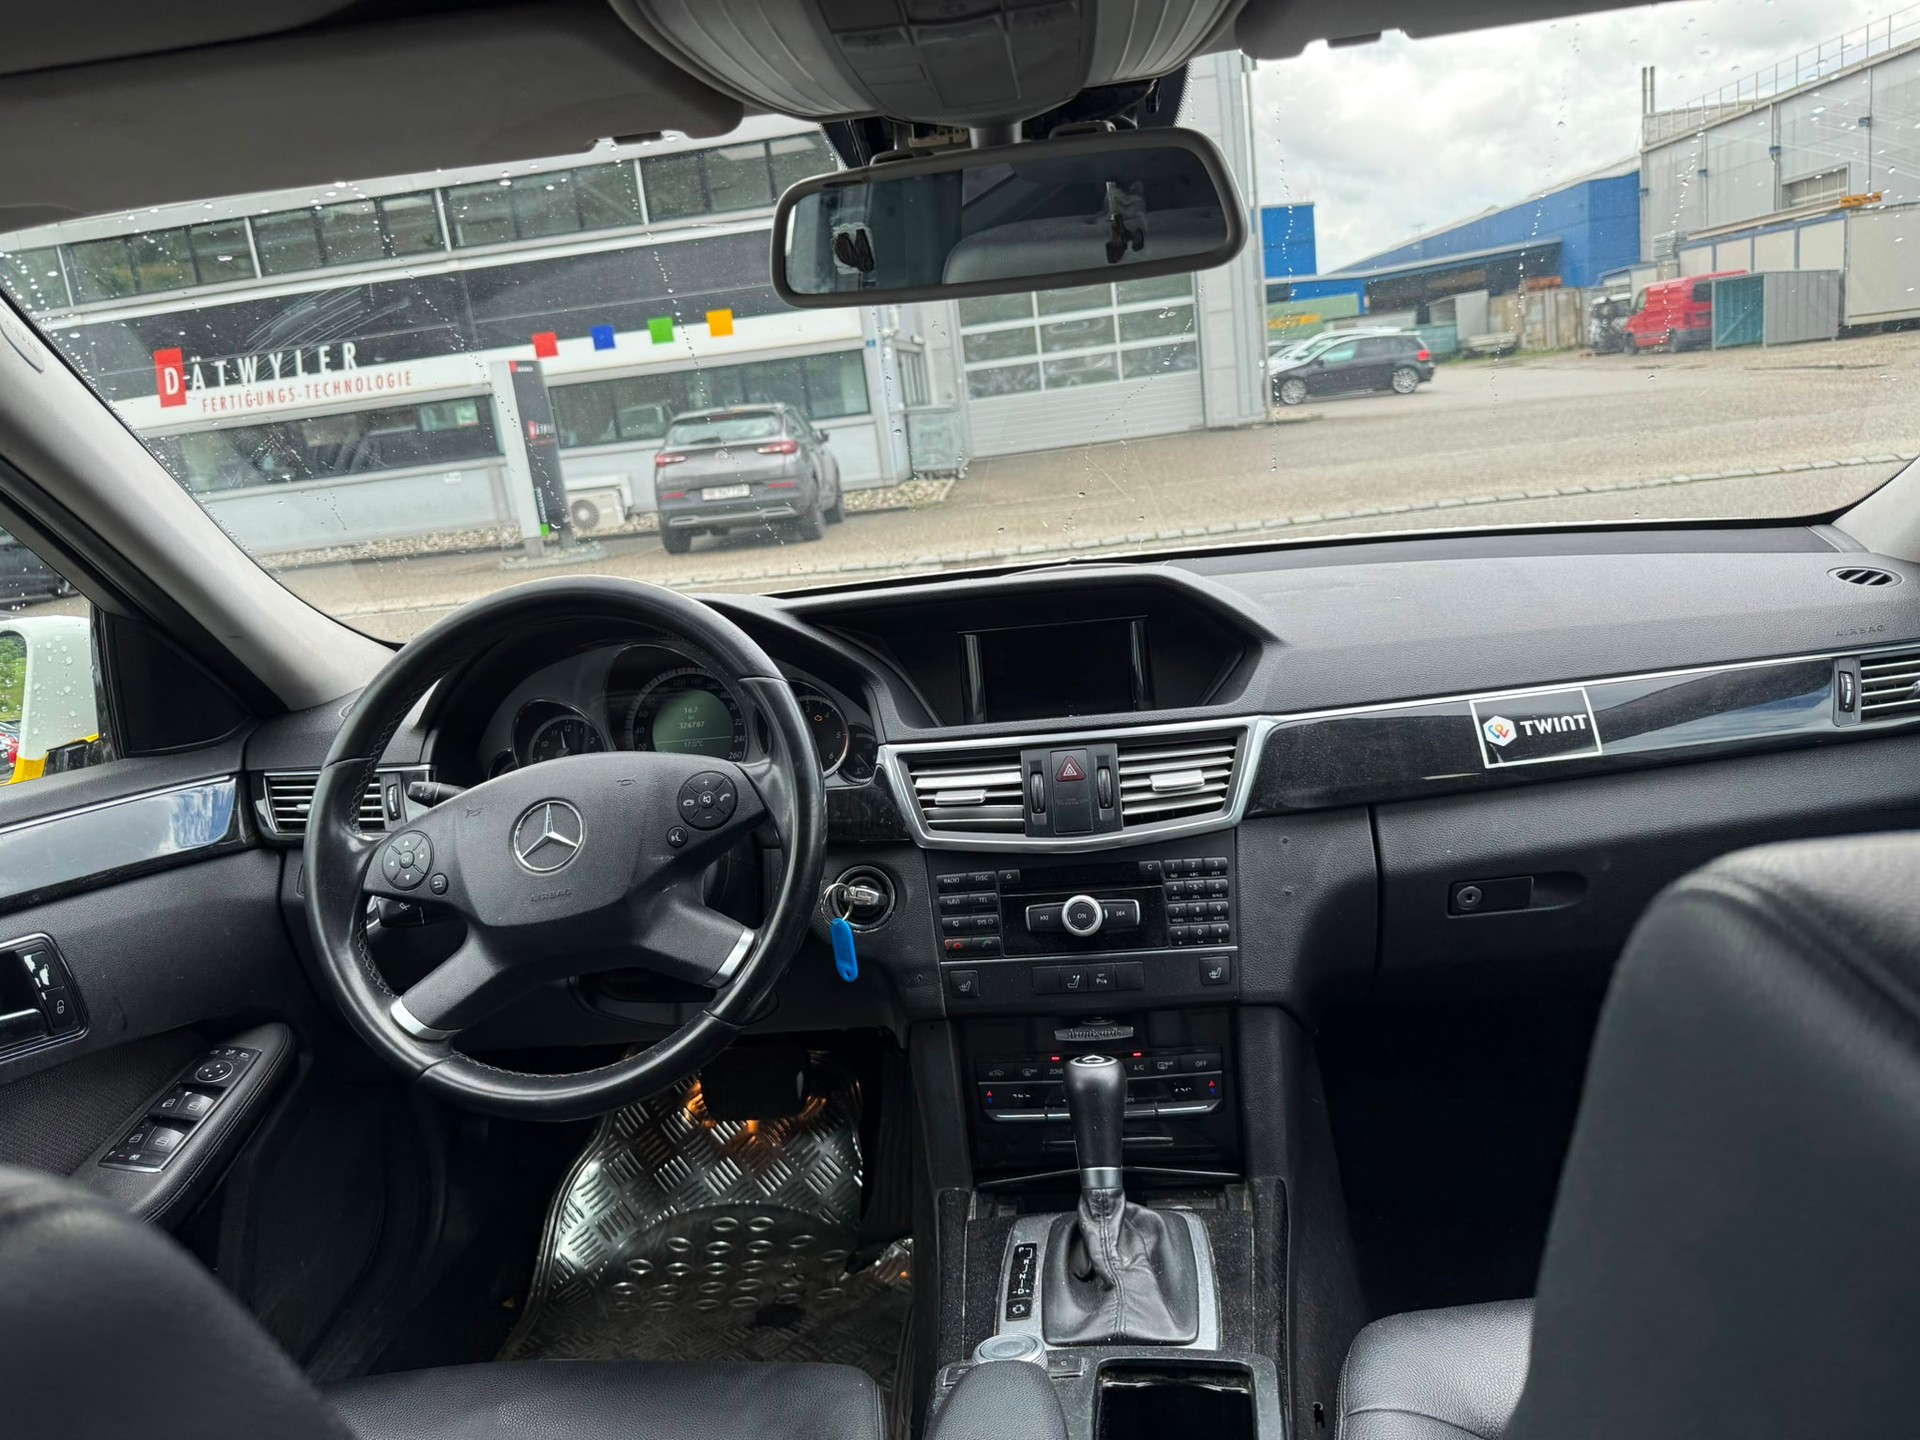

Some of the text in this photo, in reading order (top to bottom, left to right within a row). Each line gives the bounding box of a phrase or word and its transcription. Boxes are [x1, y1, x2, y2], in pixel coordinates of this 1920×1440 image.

[164, 342, 358, 396] DÄTWYLER
[1520, 713, 1588, 736] TWINT
[728, 752, 742, 760] 260
